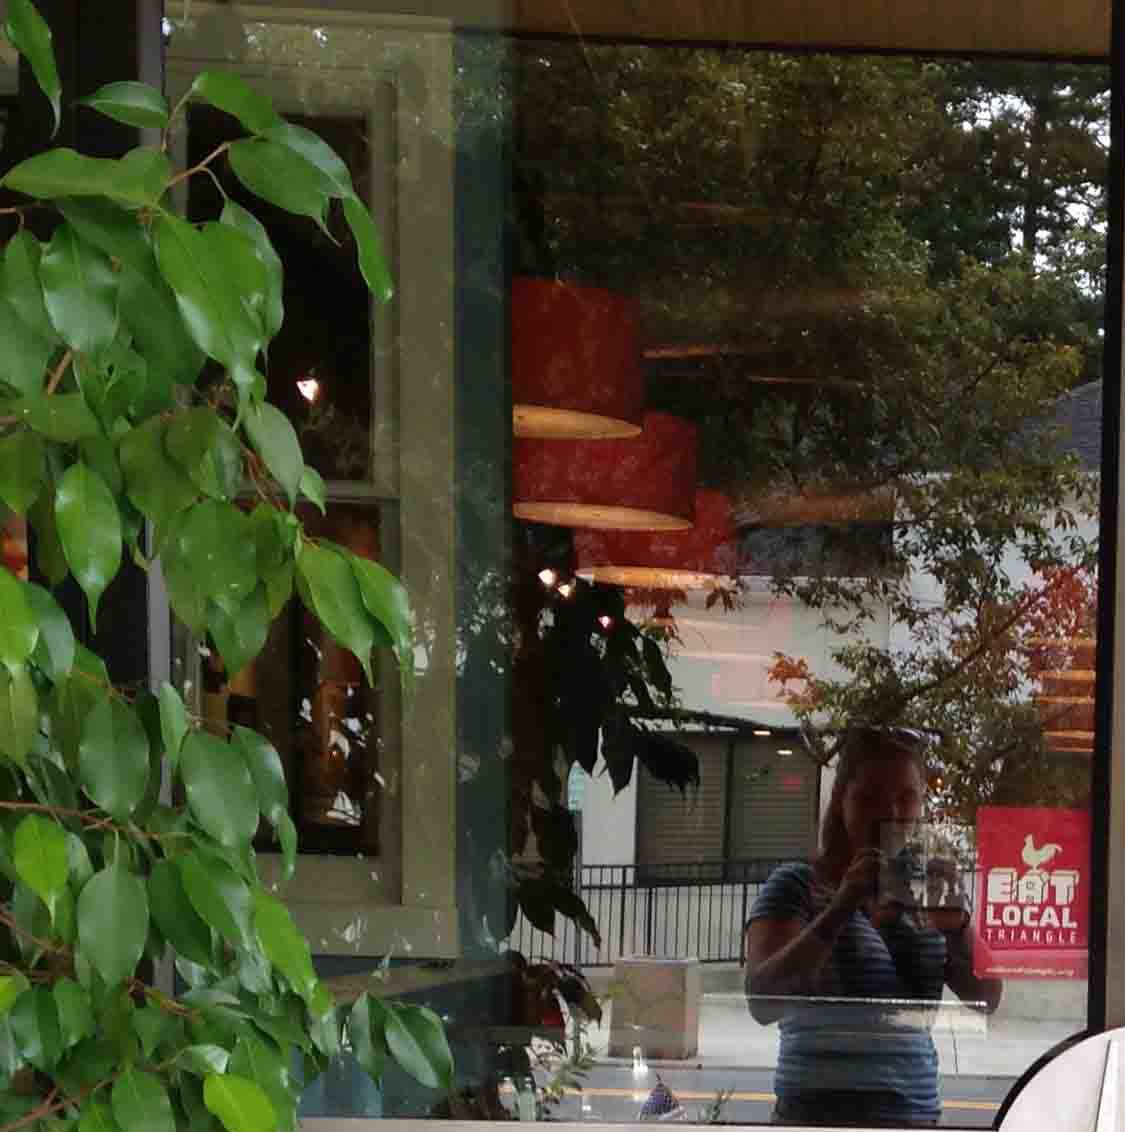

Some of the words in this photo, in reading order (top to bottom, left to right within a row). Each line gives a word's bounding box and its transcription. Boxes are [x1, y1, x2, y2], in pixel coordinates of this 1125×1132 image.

[987, 867, 1080, 905] EAT
[986, 904, 1078, 928] LOCAL
[986, 928, 1078, 944] TRIANGLE
